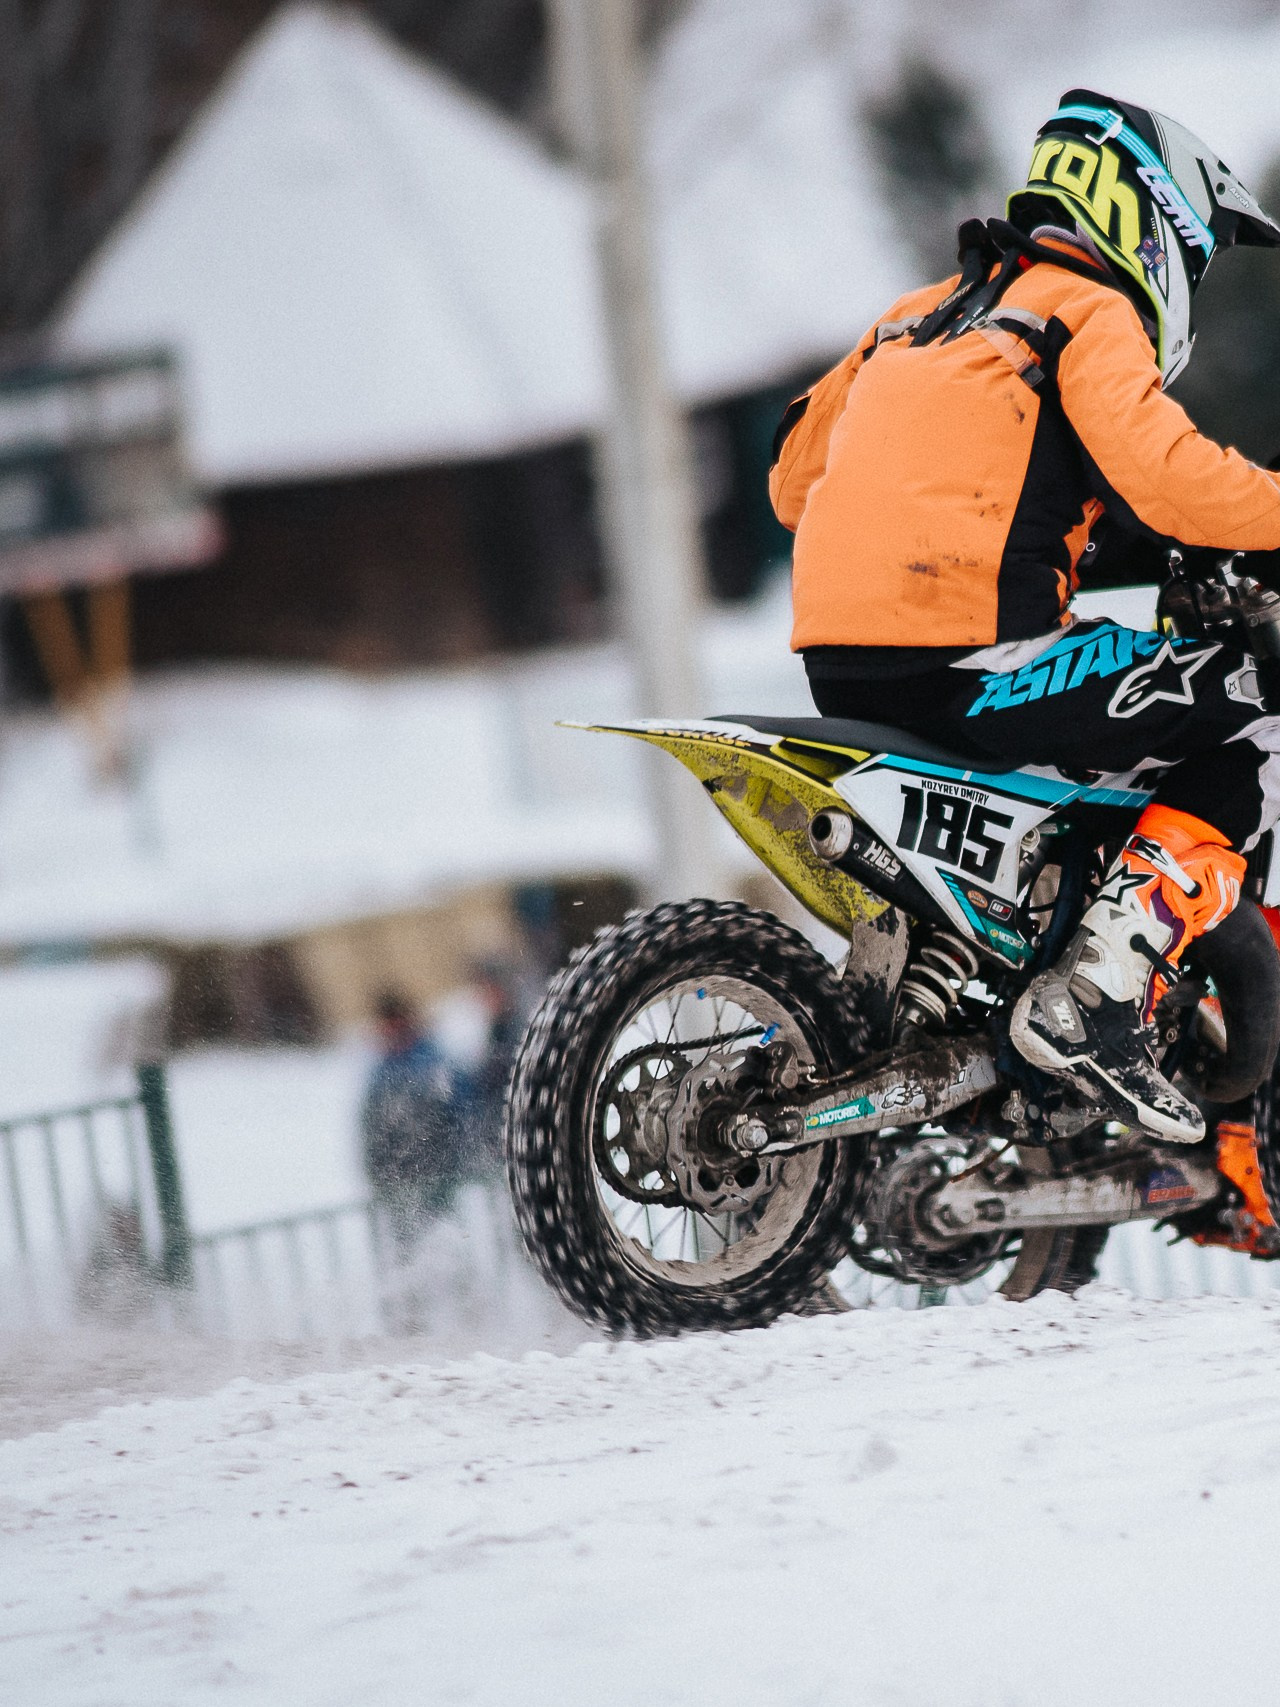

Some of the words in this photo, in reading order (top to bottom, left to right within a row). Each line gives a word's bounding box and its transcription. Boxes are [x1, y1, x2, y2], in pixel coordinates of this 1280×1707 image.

[1229, 186, 1250, 209] Airoh
[938, 281, 975, 311] LEATT
[921, 779, 960, 796] KOZYREV
[960, 787, 989, 805] DMITRY
[896, 784, 1015, 884] 185
[863, 840, 901, 876] HGS
[819, 1103, 861, 1126] MOTOREX
